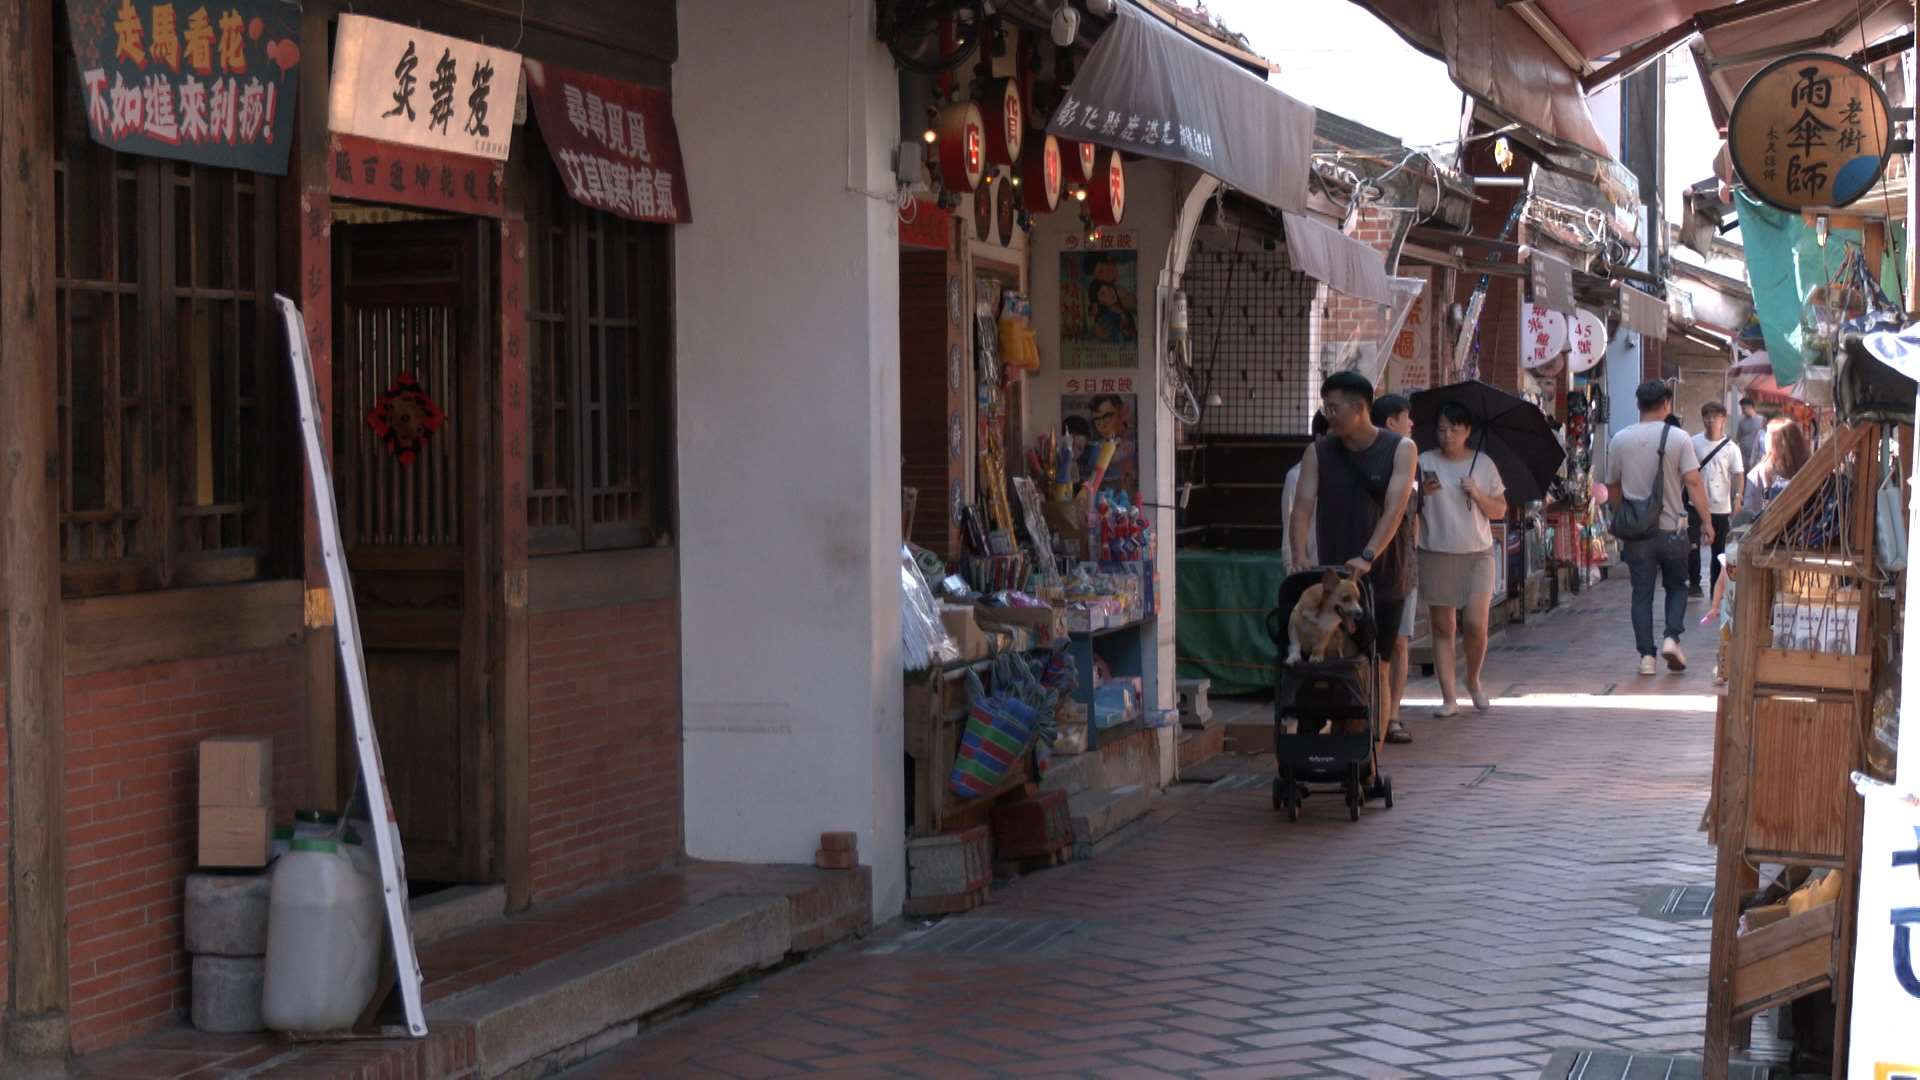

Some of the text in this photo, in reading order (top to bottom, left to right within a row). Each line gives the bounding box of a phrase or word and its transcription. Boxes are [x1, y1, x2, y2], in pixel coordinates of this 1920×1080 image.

[113, 0, 248, 74] 走馬看花
[84, 68, 276, 144] 不如進來刮痧!
[563, 83, 650, 163] 尋尋覓覓
[1786, 67, 1837, 197] 雨傘師
[1834, 97, 1866, 154] 老街
[559, 147, 677, 219] 艾草驅寒補氣
[1575, 323, 1592, 338] 45
[1066, 377, 1133, 392] 今日放映
